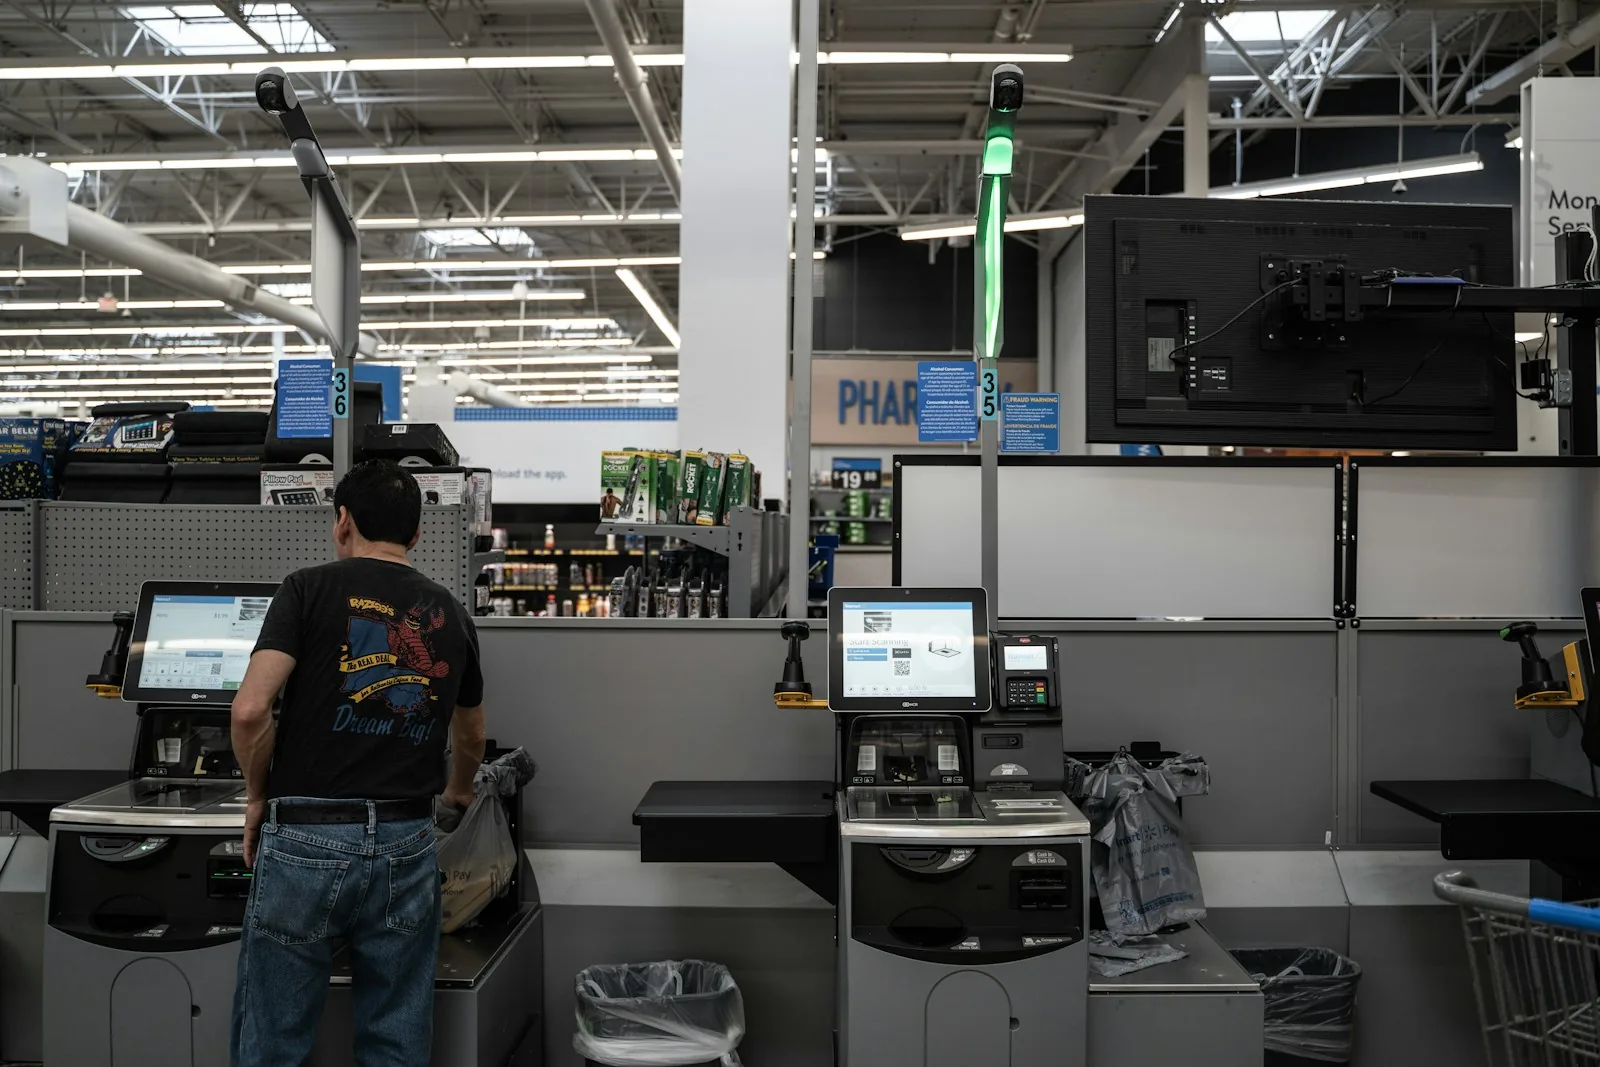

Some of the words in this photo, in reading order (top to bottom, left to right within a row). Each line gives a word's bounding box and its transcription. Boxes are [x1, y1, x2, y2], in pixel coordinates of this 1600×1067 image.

[1548, 190, 1598, 209] Mon
[839, 380, 918, 425] PHAR
[263, 475, 288, 483] Pillow
[288, 475, 304, 483] Pad
[686, 463, 696, 493] ROCKET
[357, 656, 374, 667] REAL
[375, 654, 391, 663] DEAL
[332, 704, 395, 735] Dream
[398, 712, 436, 746] Big!
[454, 870, 471, 880] Pay
